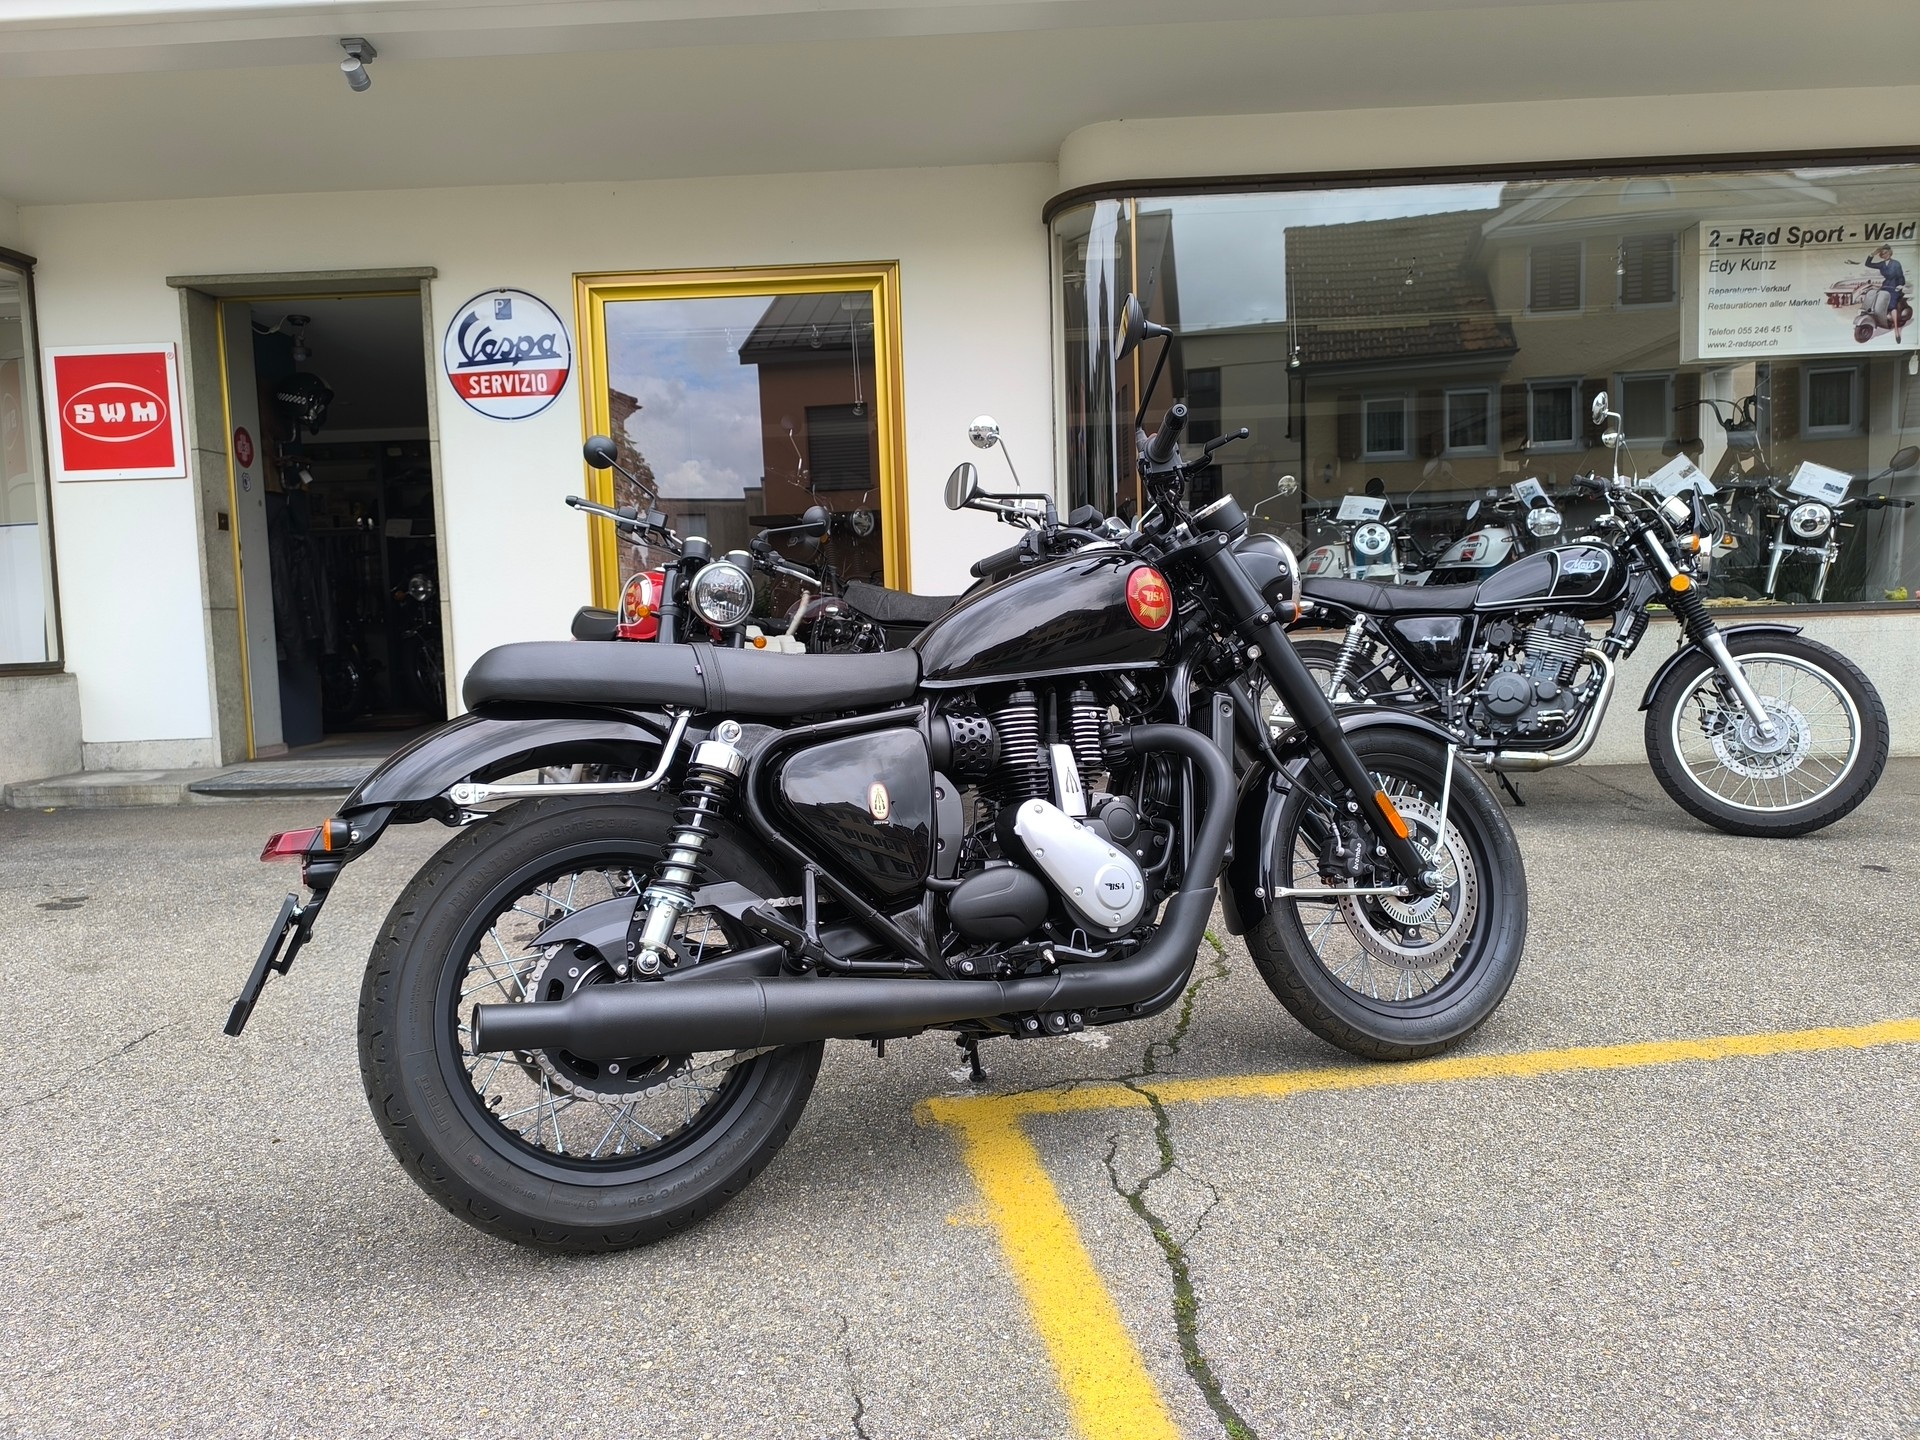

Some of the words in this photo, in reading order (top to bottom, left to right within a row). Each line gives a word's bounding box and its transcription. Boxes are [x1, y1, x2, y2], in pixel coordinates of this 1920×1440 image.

[1708, 230, 1721, 247] 2
[1738, 227, 1781, 246] Rad
[1786, 224, 1845, 248] Sport
[1864, 222, 1916, 241] Wald
[1708, 258, 1737, 275] Edy
[1740, 257, 1777, 272] Kunz
[1707, 300, 1768, 310] Restaurationen
[1769, 299, 1787, 308] aller
[1788, 298, 1821, 308] Marken!
[1708, 326, 1736, 336] Telefon
[1737, 326, 1753, 334] 055
[1754, 325, 1769, 334] 246
[1770, 325, 1782, 333] 45
[1784, 324, 1793, 333] 15
[456, 310, 562, 368] Vespa
[1707, 338, 1779, 349] www.2-radsport.ch
[469, 373, 548, 395] SERVIZIO
[73, 401, 158, 424] SWM
[1142, 590, 1165, 602] BSA
[1104, 882, 1125, 891] BSA
